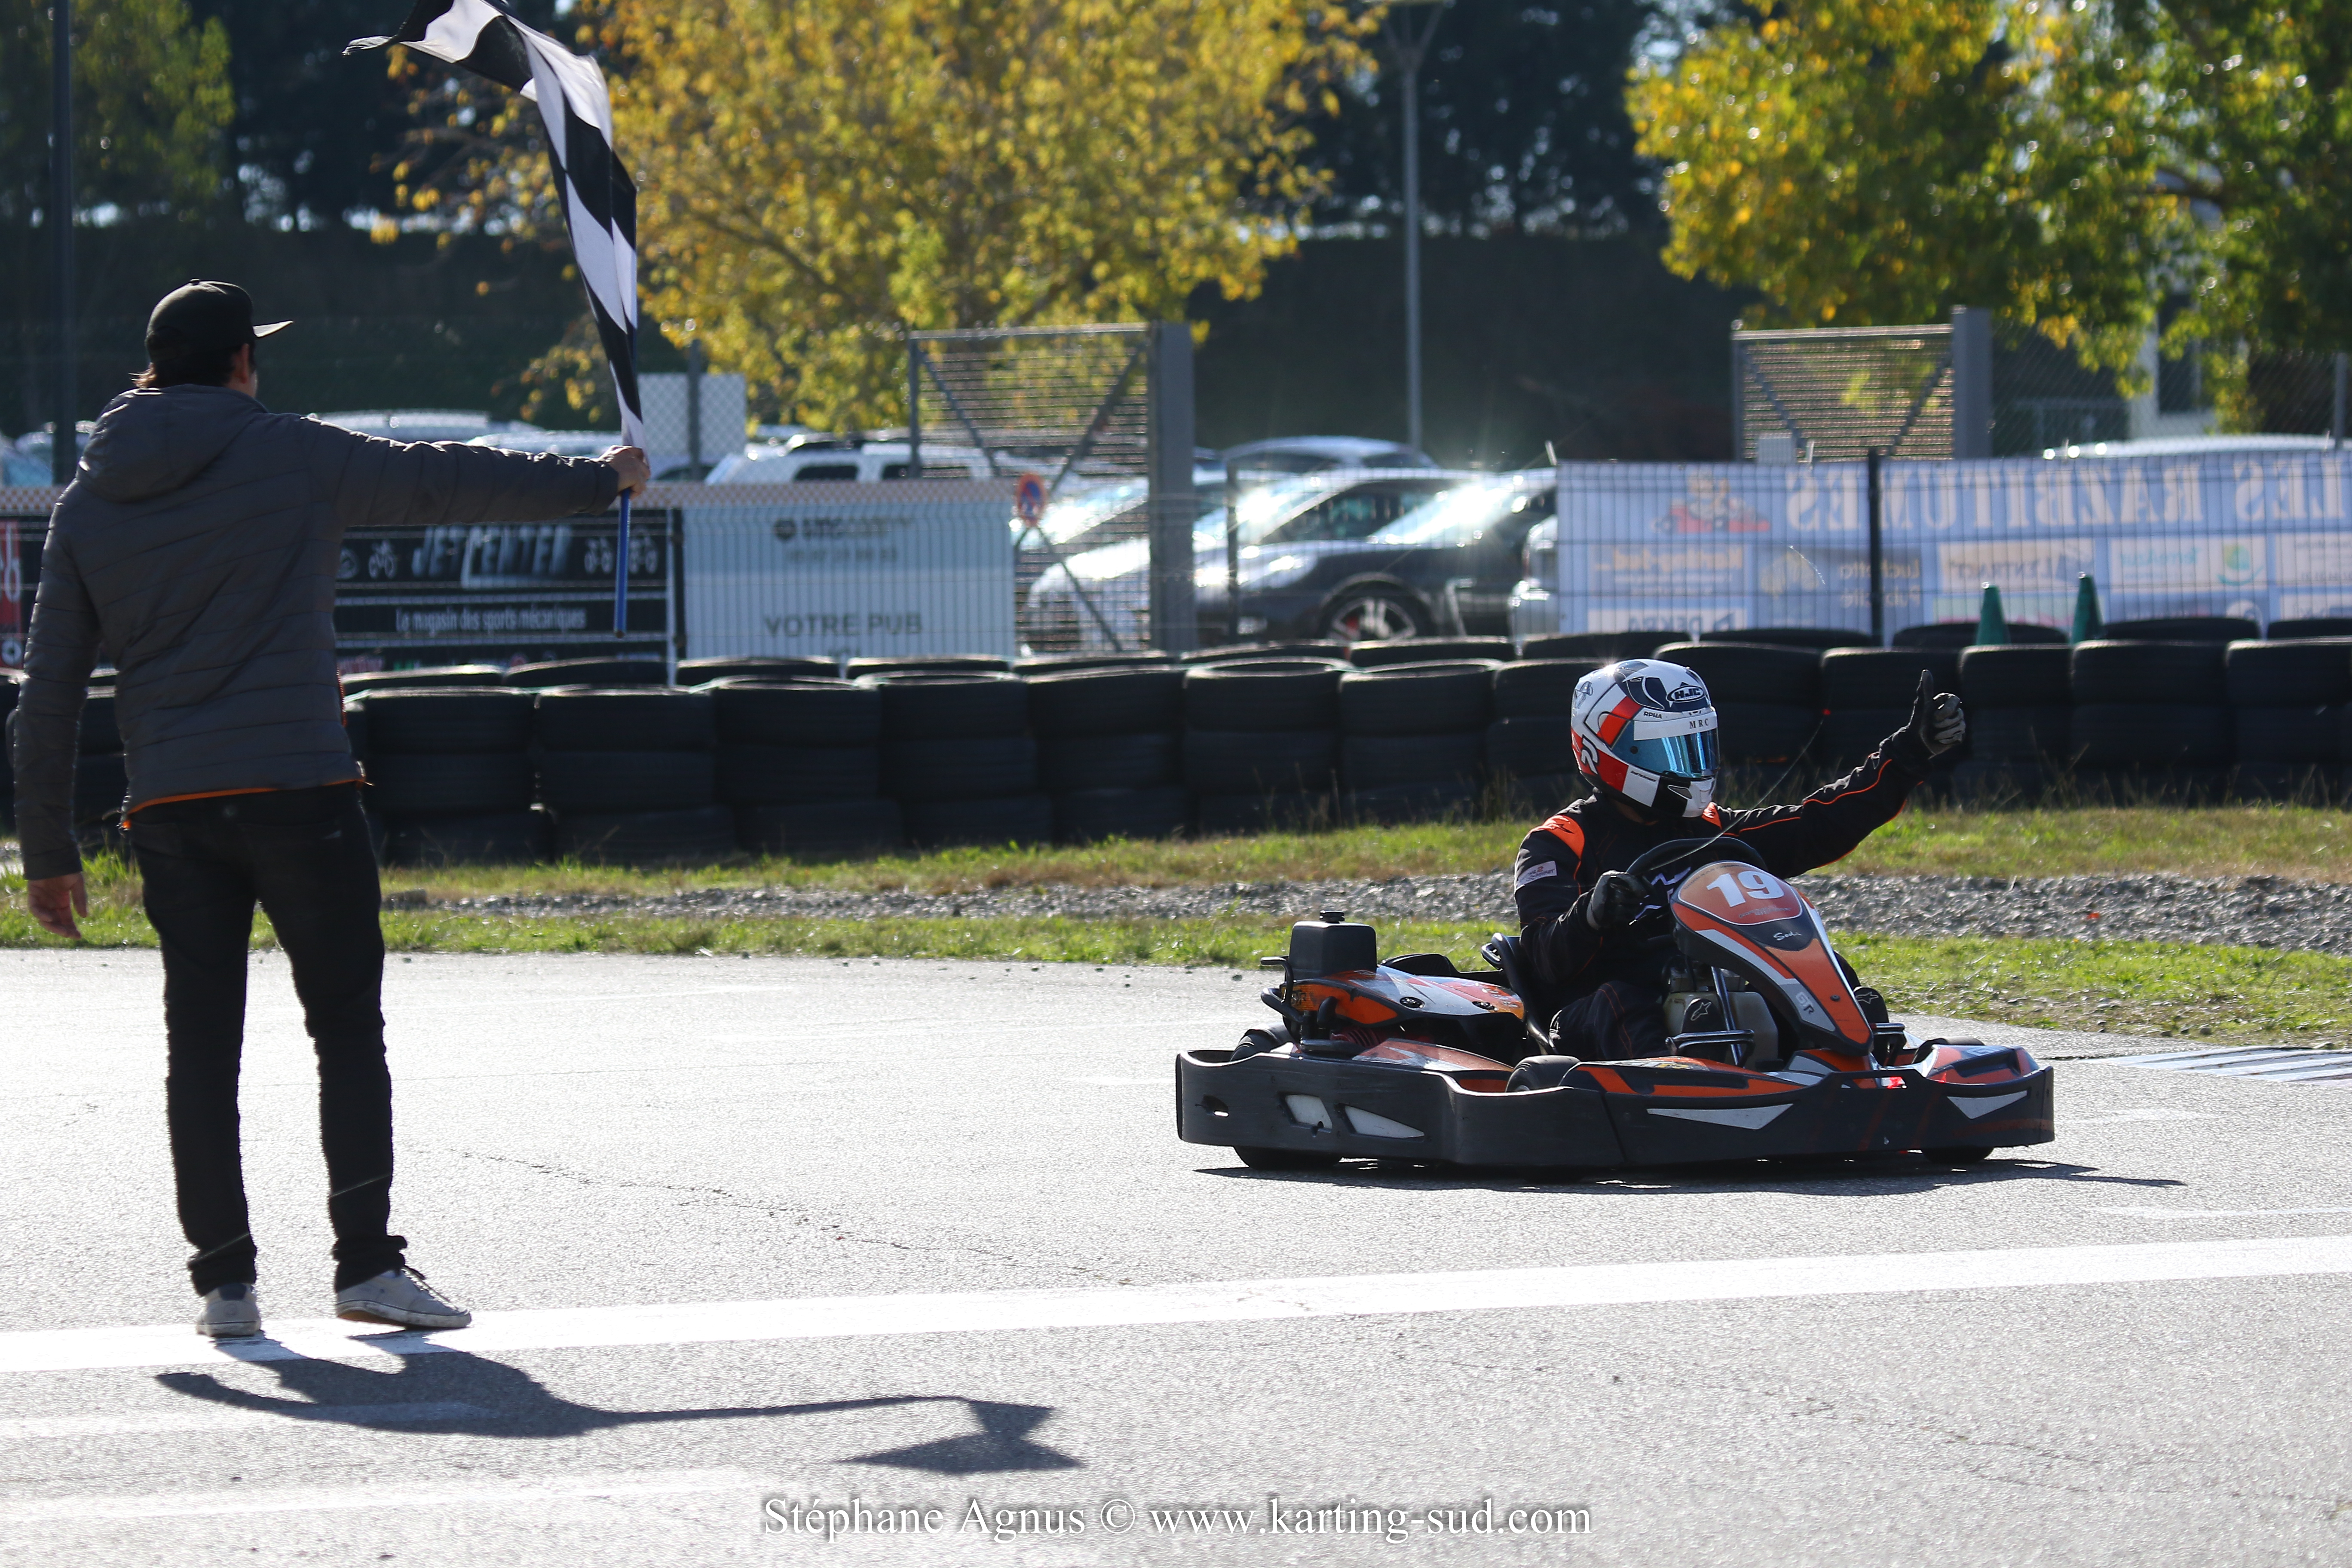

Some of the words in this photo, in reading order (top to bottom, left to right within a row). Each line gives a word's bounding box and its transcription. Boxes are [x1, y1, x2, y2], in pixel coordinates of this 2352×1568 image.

[412, 606, 458, 637] magasin
[460, 606, 480, 632] des
[481, 607, 517, 636] sports
[763, 612, 861, 639] VOTRE
[867, 610, 923, 636] PUB
[1674, 688, 1701, 700] HJC
[1644, 711, 1663, 719] RPHA
[1706, 870, 1784, 908] 19
